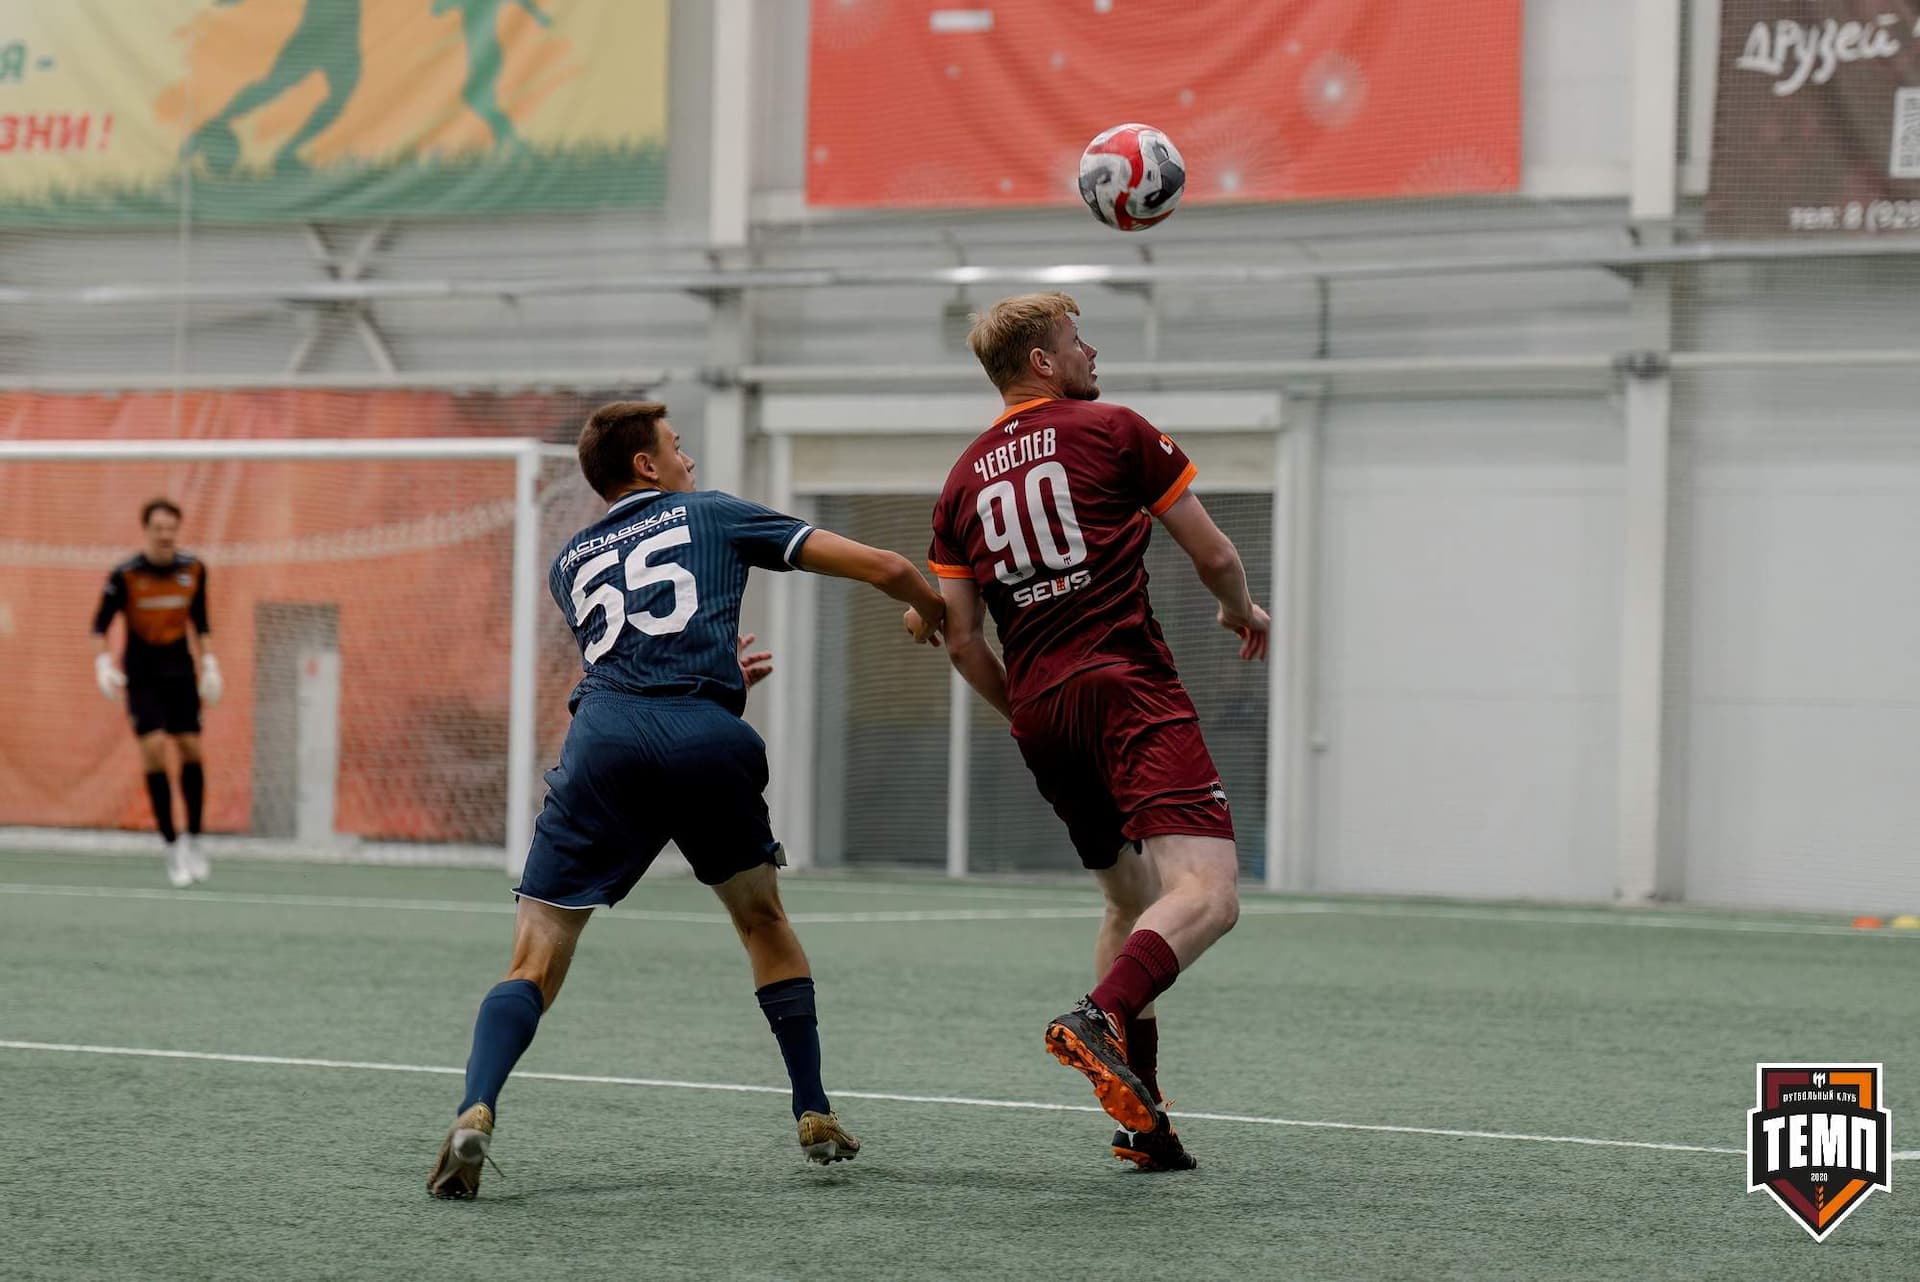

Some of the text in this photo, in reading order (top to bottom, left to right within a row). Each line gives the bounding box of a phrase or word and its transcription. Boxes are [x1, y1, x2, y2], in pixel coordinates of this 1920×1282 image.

[1844, 201, 1862, 229] 8
[973, 427, 1056, 482] ЧЕВЕЛЕВ
[977, 461, 1088, 585] 90
[571, 525, 699, 665] 55
[1013, 569, 1092, 608] SEUS
